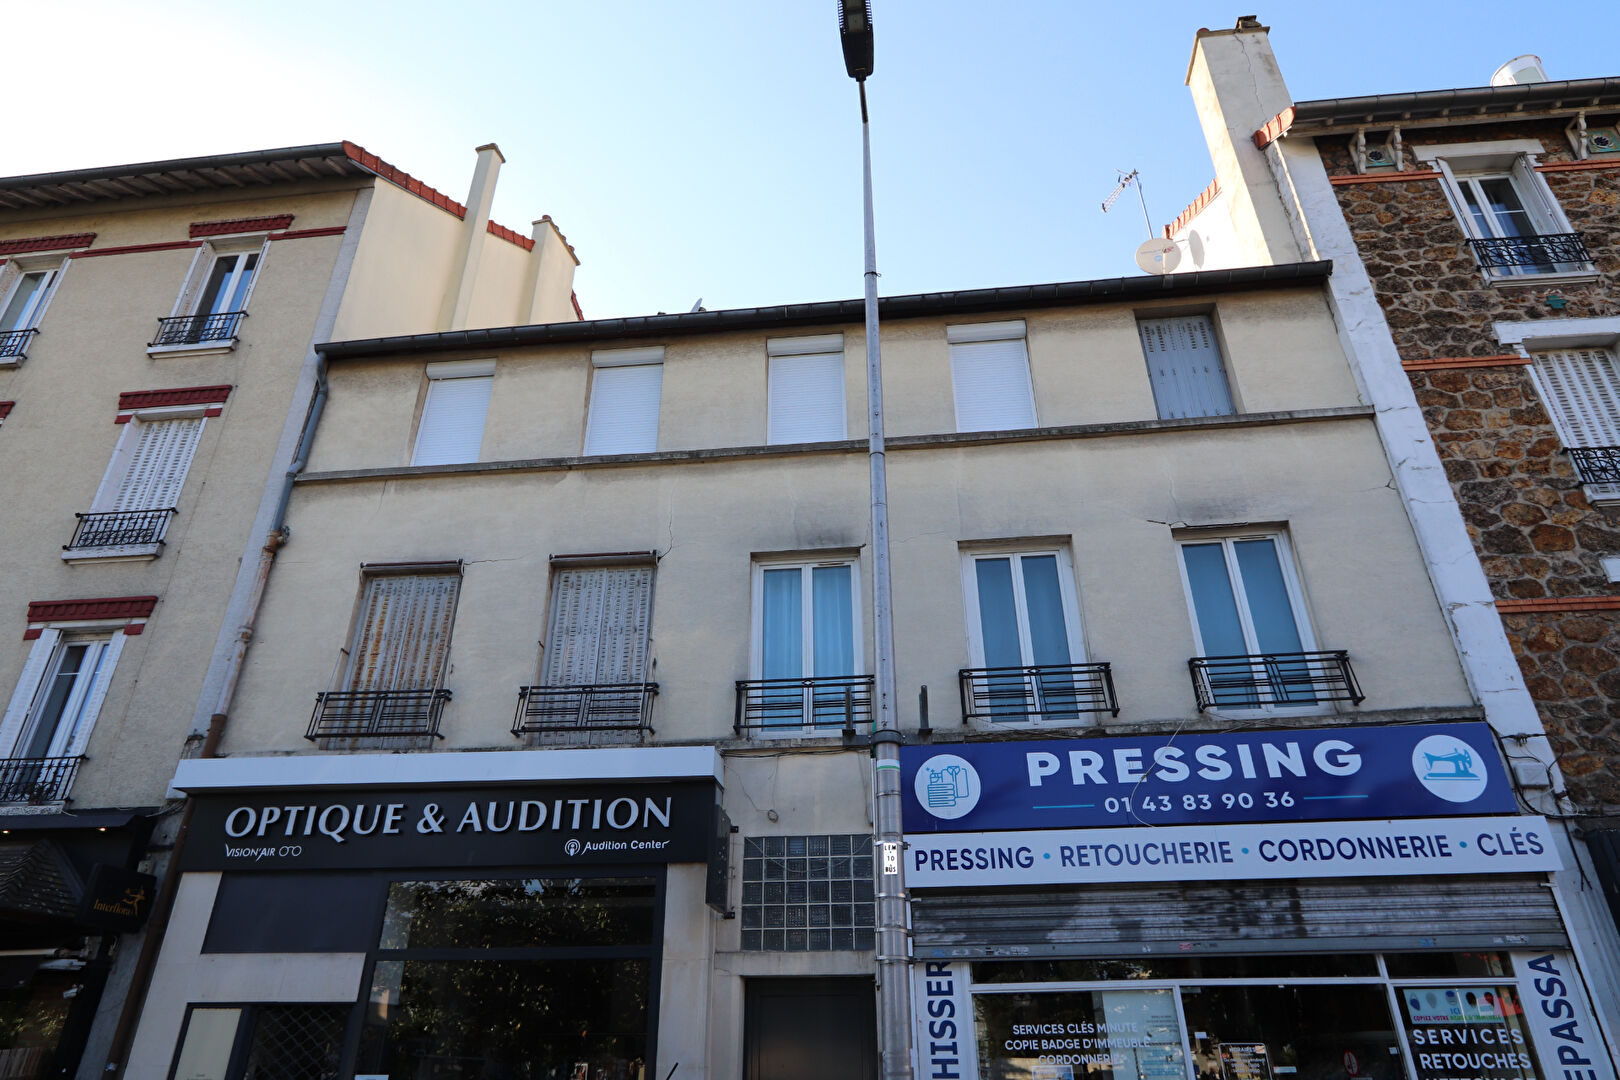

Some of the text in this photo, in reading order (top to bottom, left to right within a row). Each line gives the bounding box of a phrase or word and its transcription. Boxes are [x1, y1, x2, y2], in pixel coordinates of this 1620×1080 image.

[1026, 739, 1363, 787] PRESSING
[1104, 791, 1295, 814] 01 43 83 90 36
[224, 797, 672, 843] OPTIQUE & AUDITION
[581, 839, 670, 856] Audition Center
[915, 827, 1544, 872] PRESSING RETOUCHERIE CORDONNERIE CLÉS
[1012, 1023, 1065, 1035] SERVICES
[1067, 1020, 1095, 1034] CLÉS
[1097, 1022, 1138, 1034] MINUTE
[1412, 1028, 1524, 1045] SERVICES
[1004, 1036, 1151, 1051] COPIE BADGE D'IMMEUBLE
[1418, 1052, 1532, 1070] RETOUCHES
